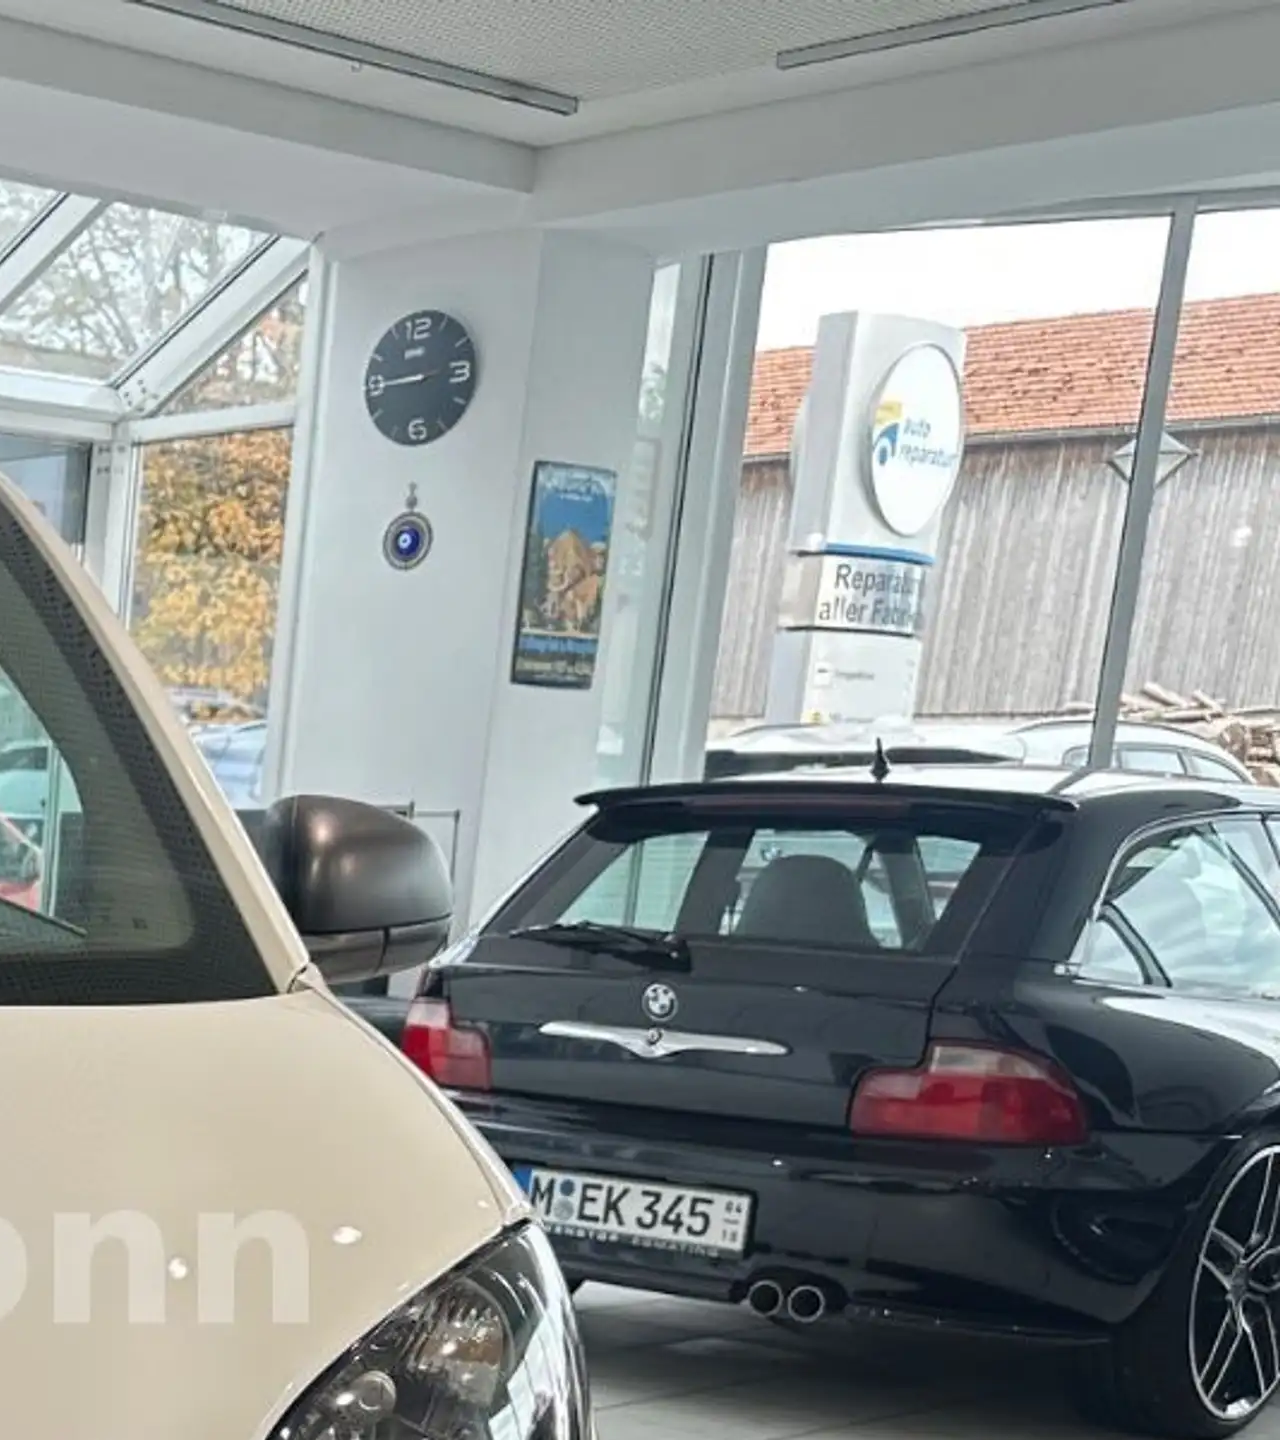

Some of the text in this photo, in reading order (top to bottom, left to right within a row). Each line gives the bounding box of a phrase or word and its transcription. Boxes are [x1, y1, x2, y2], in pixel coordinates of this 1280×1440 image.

[405, 317, 432, 341] 12
[449, 360, 471, 383] 3
[368, 374, 385, 397] 9
[408, 416, 428, 440] 6
[819, 596, 868, 623] aller
[531, 1177, 714, 1237] M EK 345
